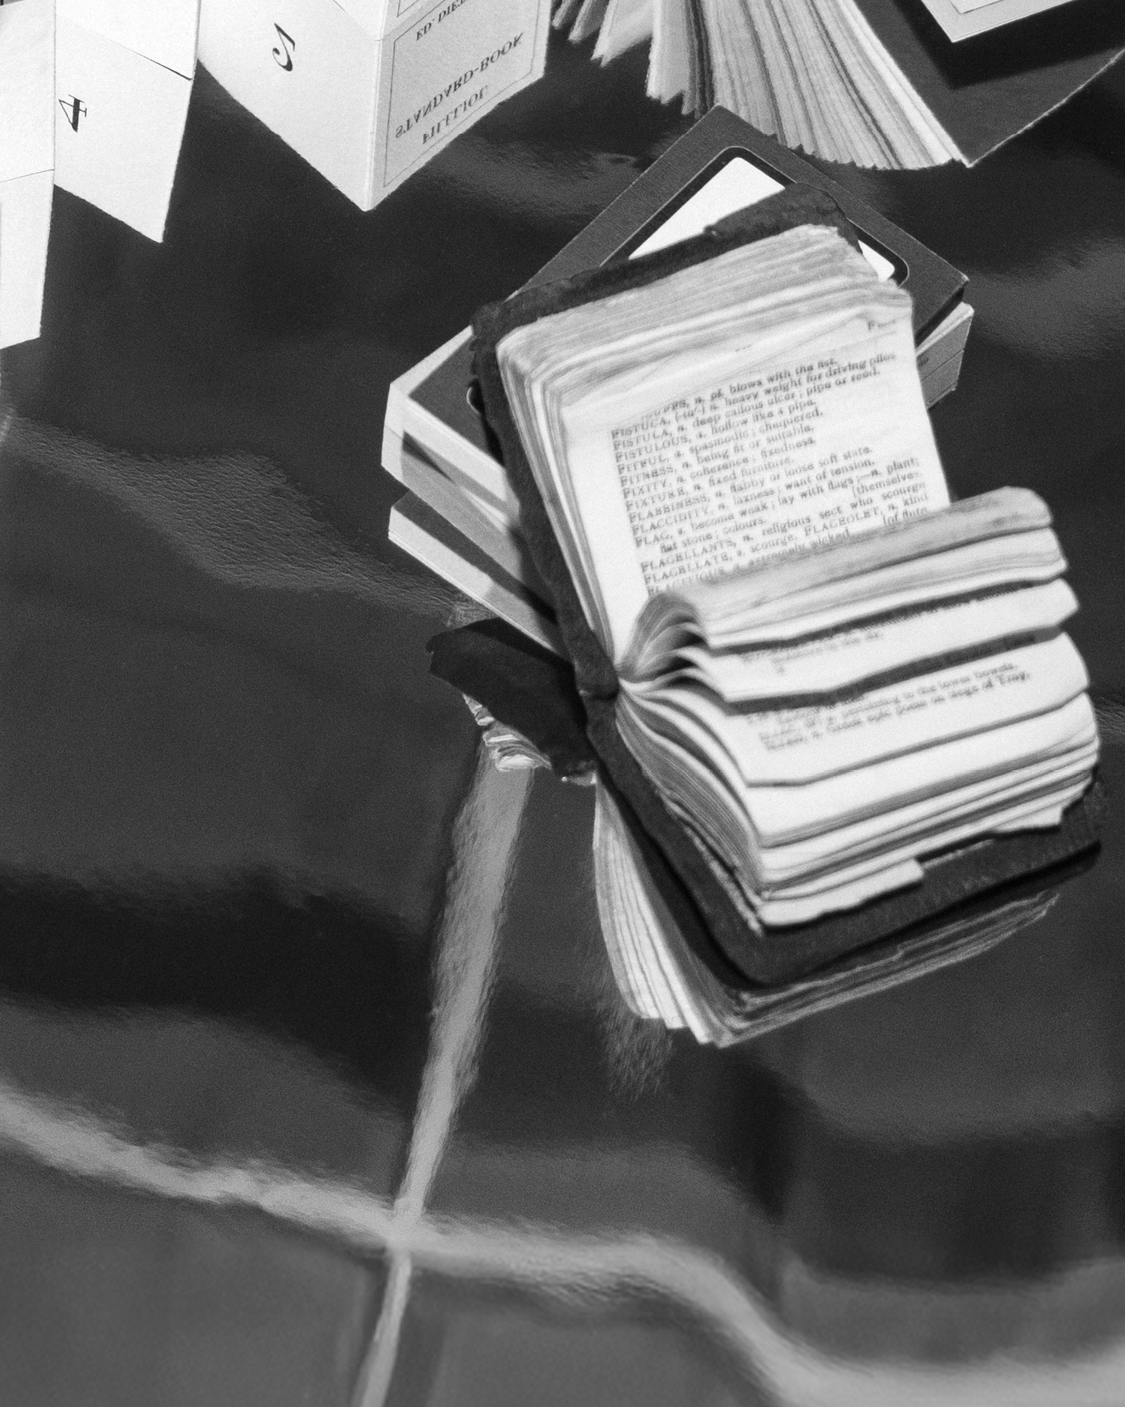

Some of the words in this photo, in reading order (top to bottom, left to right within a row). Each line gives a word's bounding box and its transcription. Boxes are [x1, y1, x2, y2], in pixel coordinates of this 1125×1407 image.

[763, 376, 801, 395] weight
[824, 359, 867, 378] driving
[613, 434, 691, 463] FISTULOUS,
[709, 417, 748, 434] hollow
[784, 475, 811, 490] want
[799, 485, 824, 499] with
[761, 515, 811, 536] religious
[818, 505, 842, 519] sect
[849, 496, 873, 509] who
